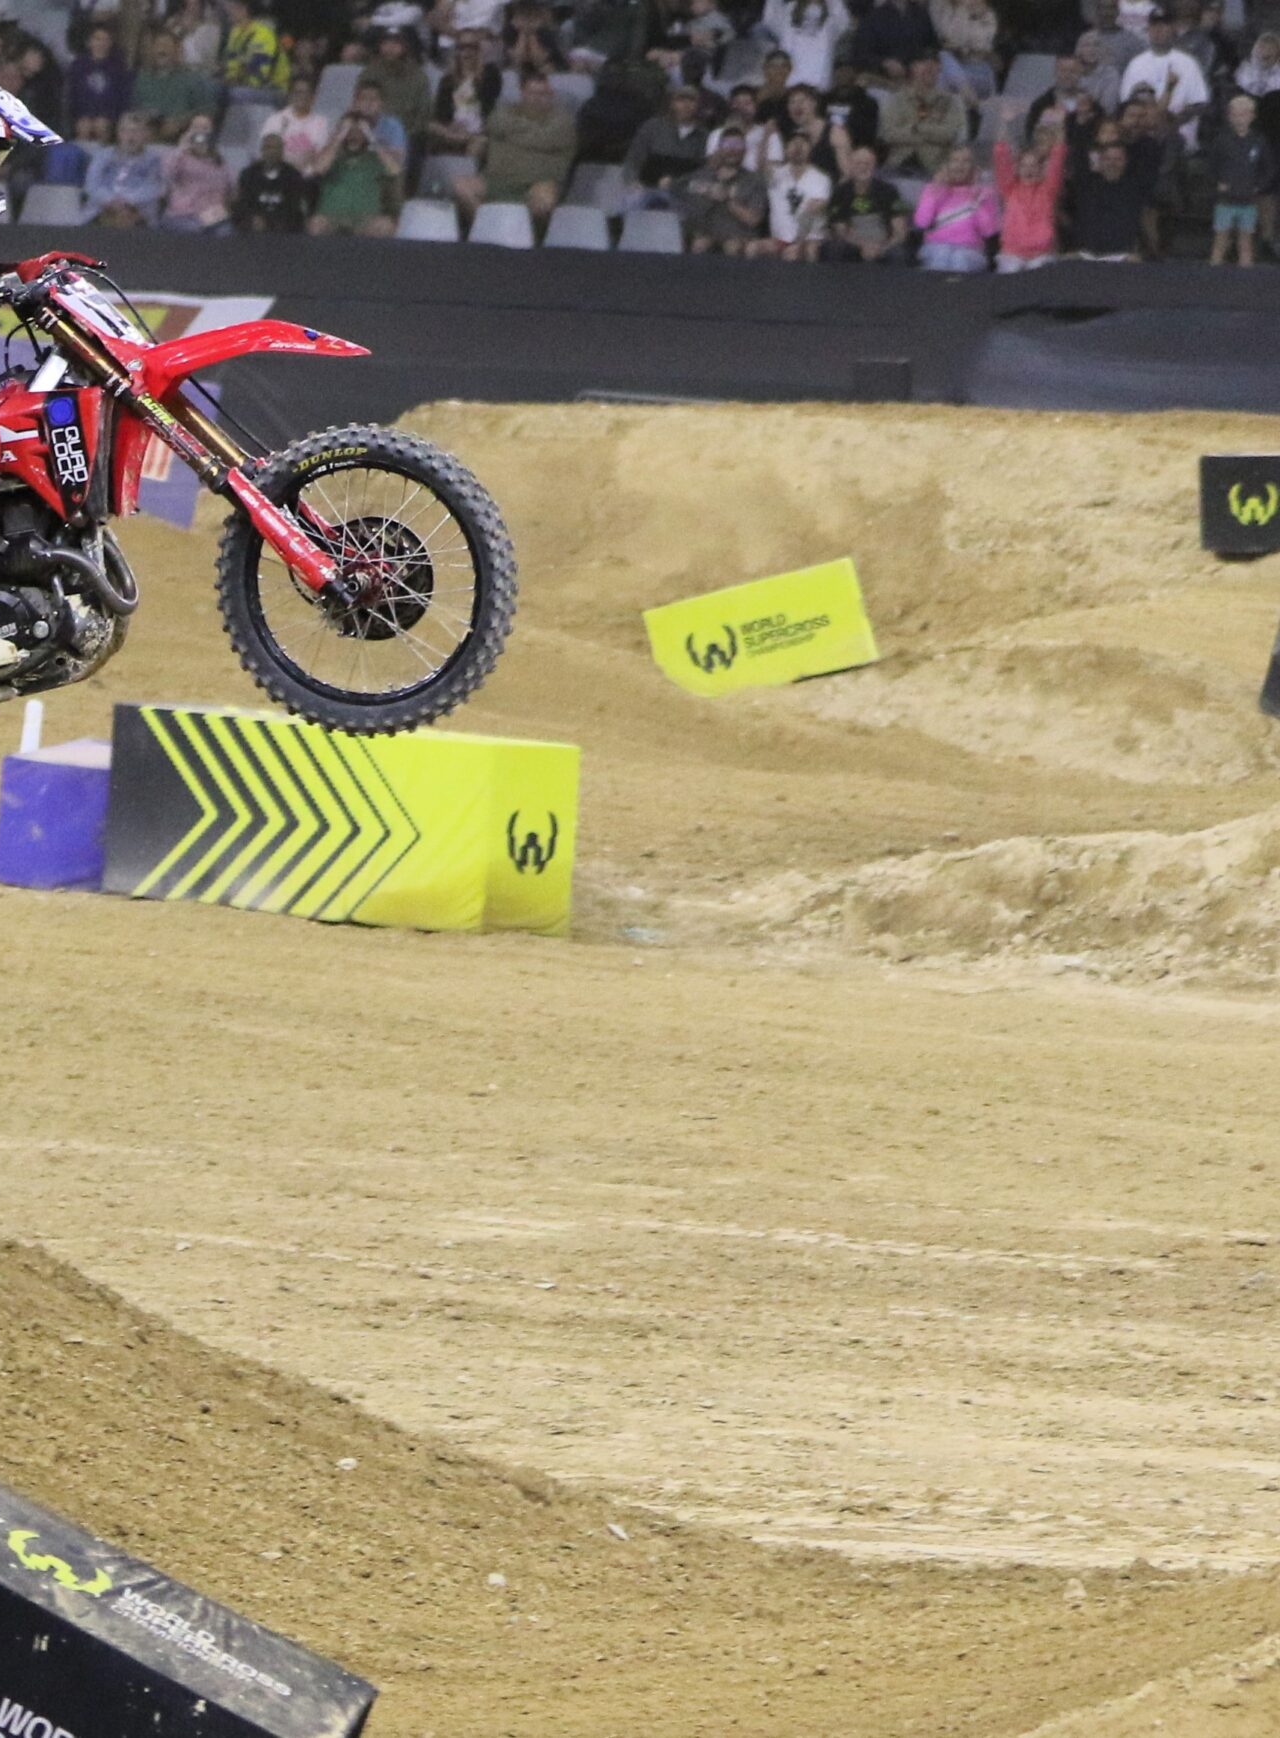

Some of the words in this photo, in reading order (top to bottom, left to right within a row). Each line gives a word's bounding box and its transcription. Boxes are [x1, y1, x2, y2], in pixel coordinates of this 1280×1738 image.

[51, 428, 75, 485] LOCK
[63, 426, 89, 483] QUAD
[298, 447, 368, 471] DUNLOP
[741, 614, 787, 635] WORLD
[744, 614, 831, 649] SUPERCROSS
[123, 1587, 216, 1645] WORLD
[116, 1598, 293, 1696] SUPERCROSS
